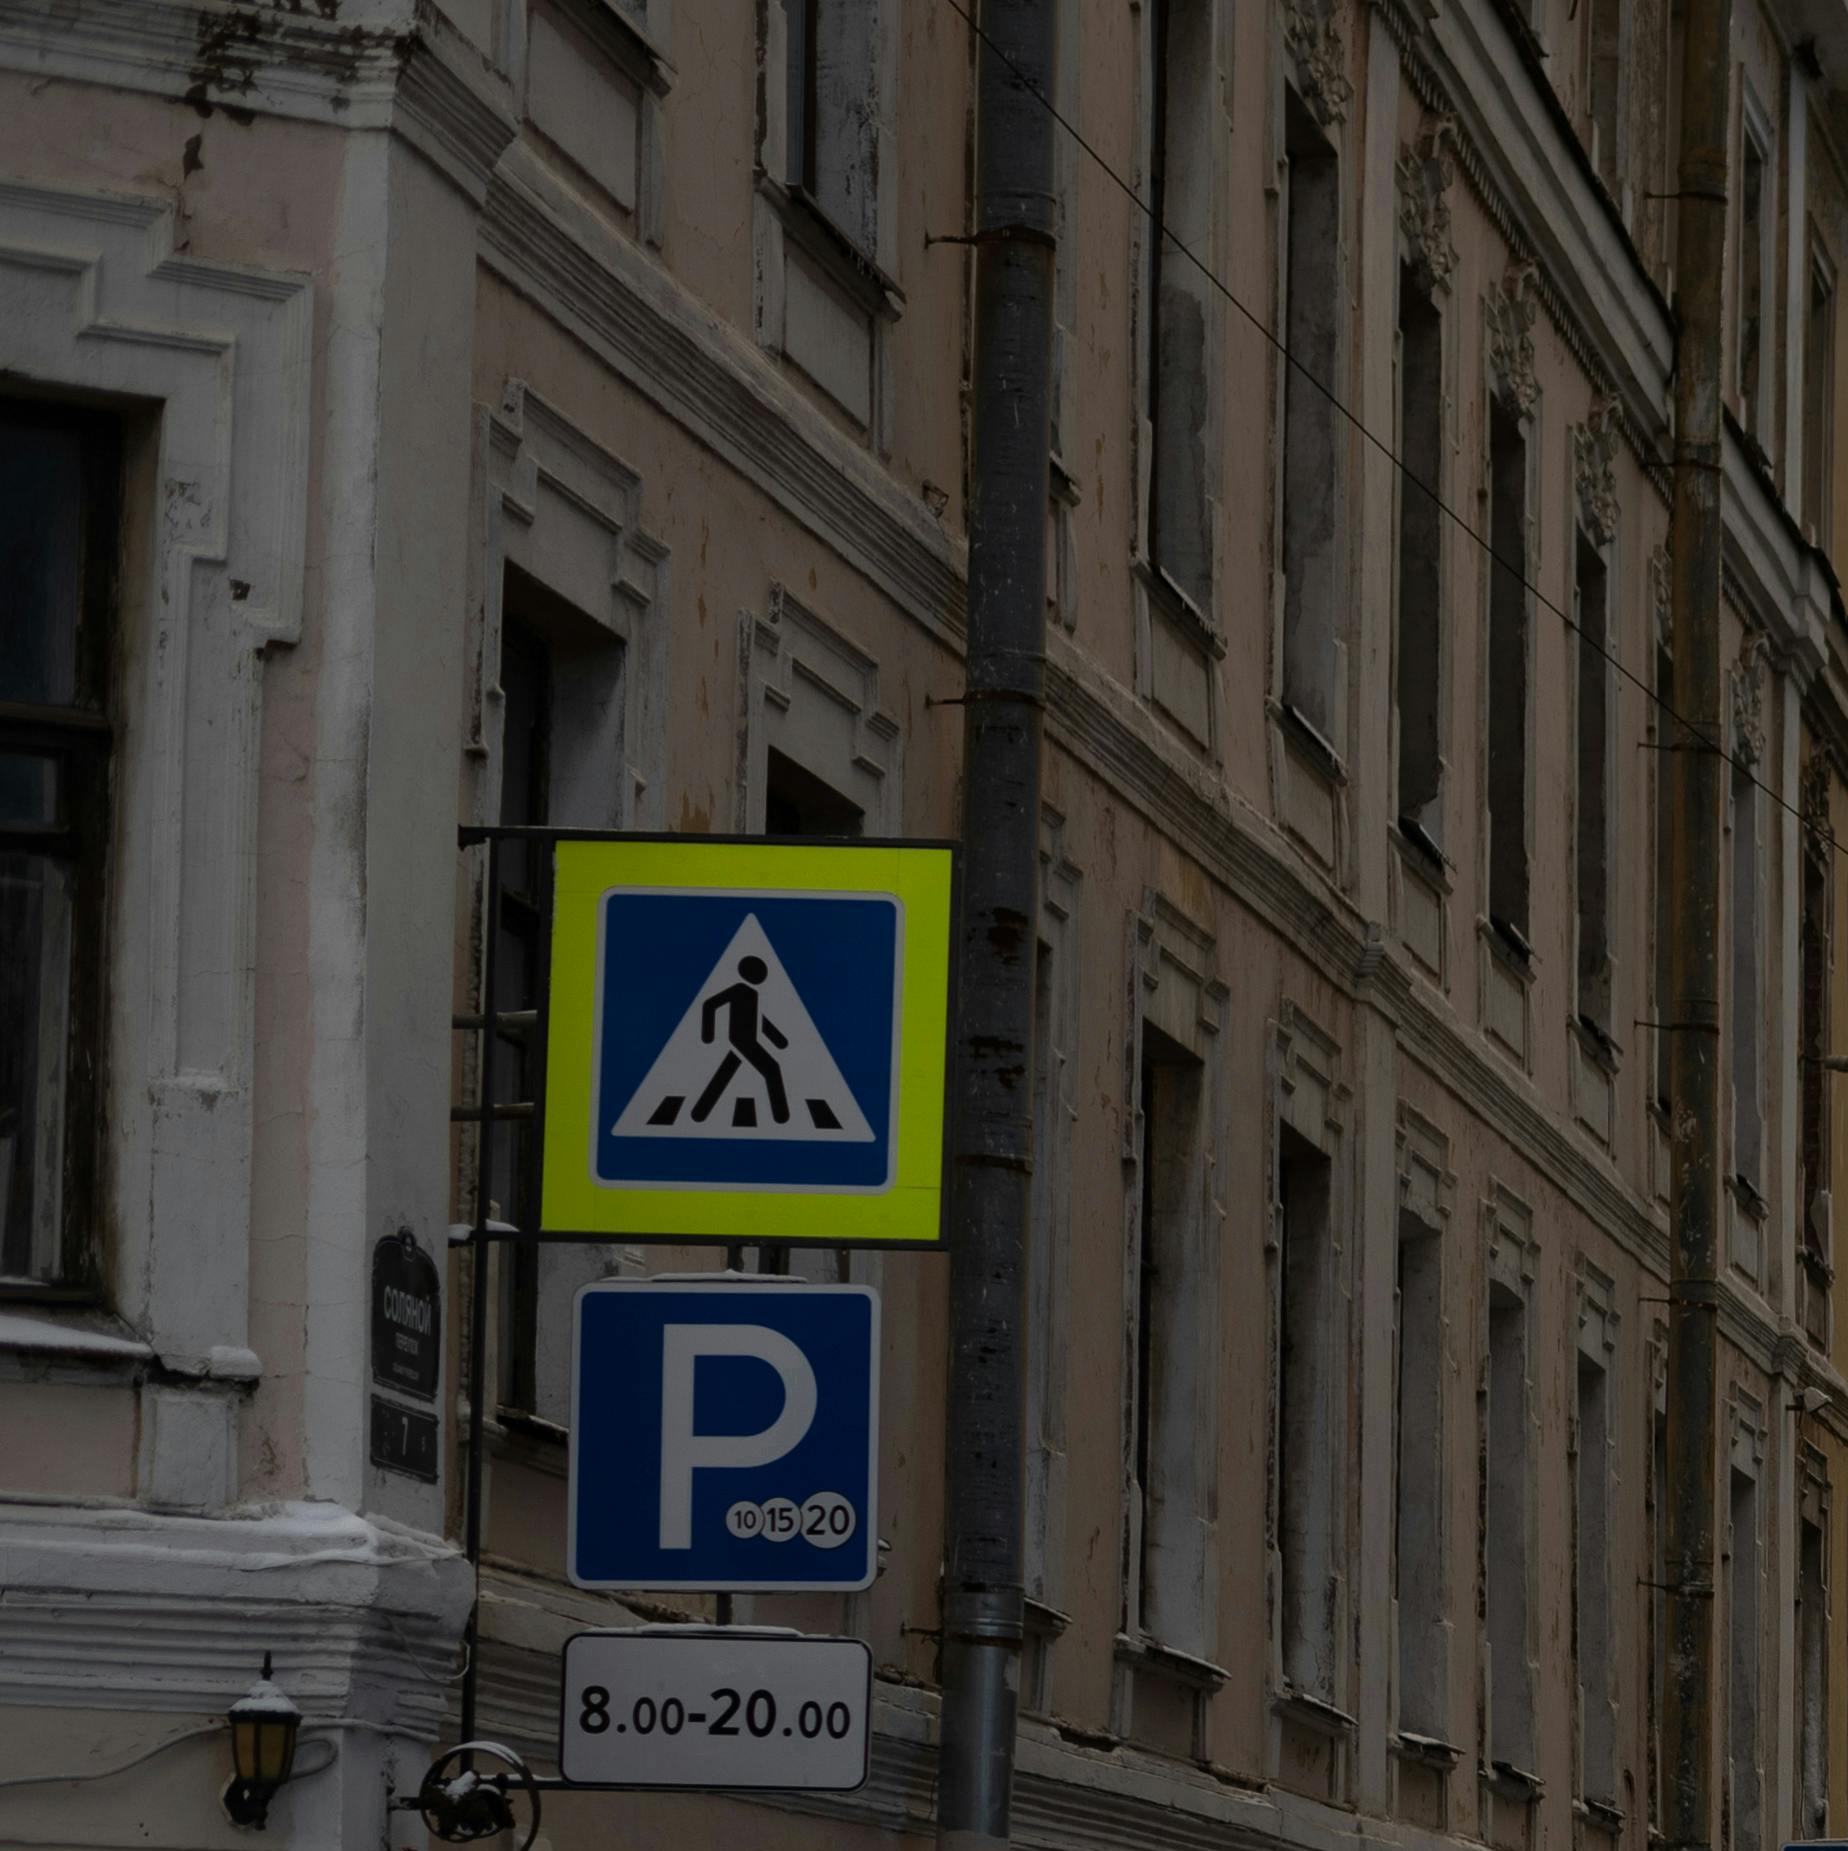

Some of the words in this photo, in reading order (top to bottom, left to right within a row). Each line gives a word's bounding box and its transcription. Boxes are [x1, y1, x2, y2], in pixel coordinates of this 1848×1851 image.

[383, 1285, 432, 1337] СОЛЯНОЙ
[659, 1323, 818, 1550] P
[735, 1510, 757, 1529] 10
[767, 1507, 794, 1532] 15
[806, 1505, 850, 1535] 20
[579, 1685, 850, 1739] 8.00-20.00
